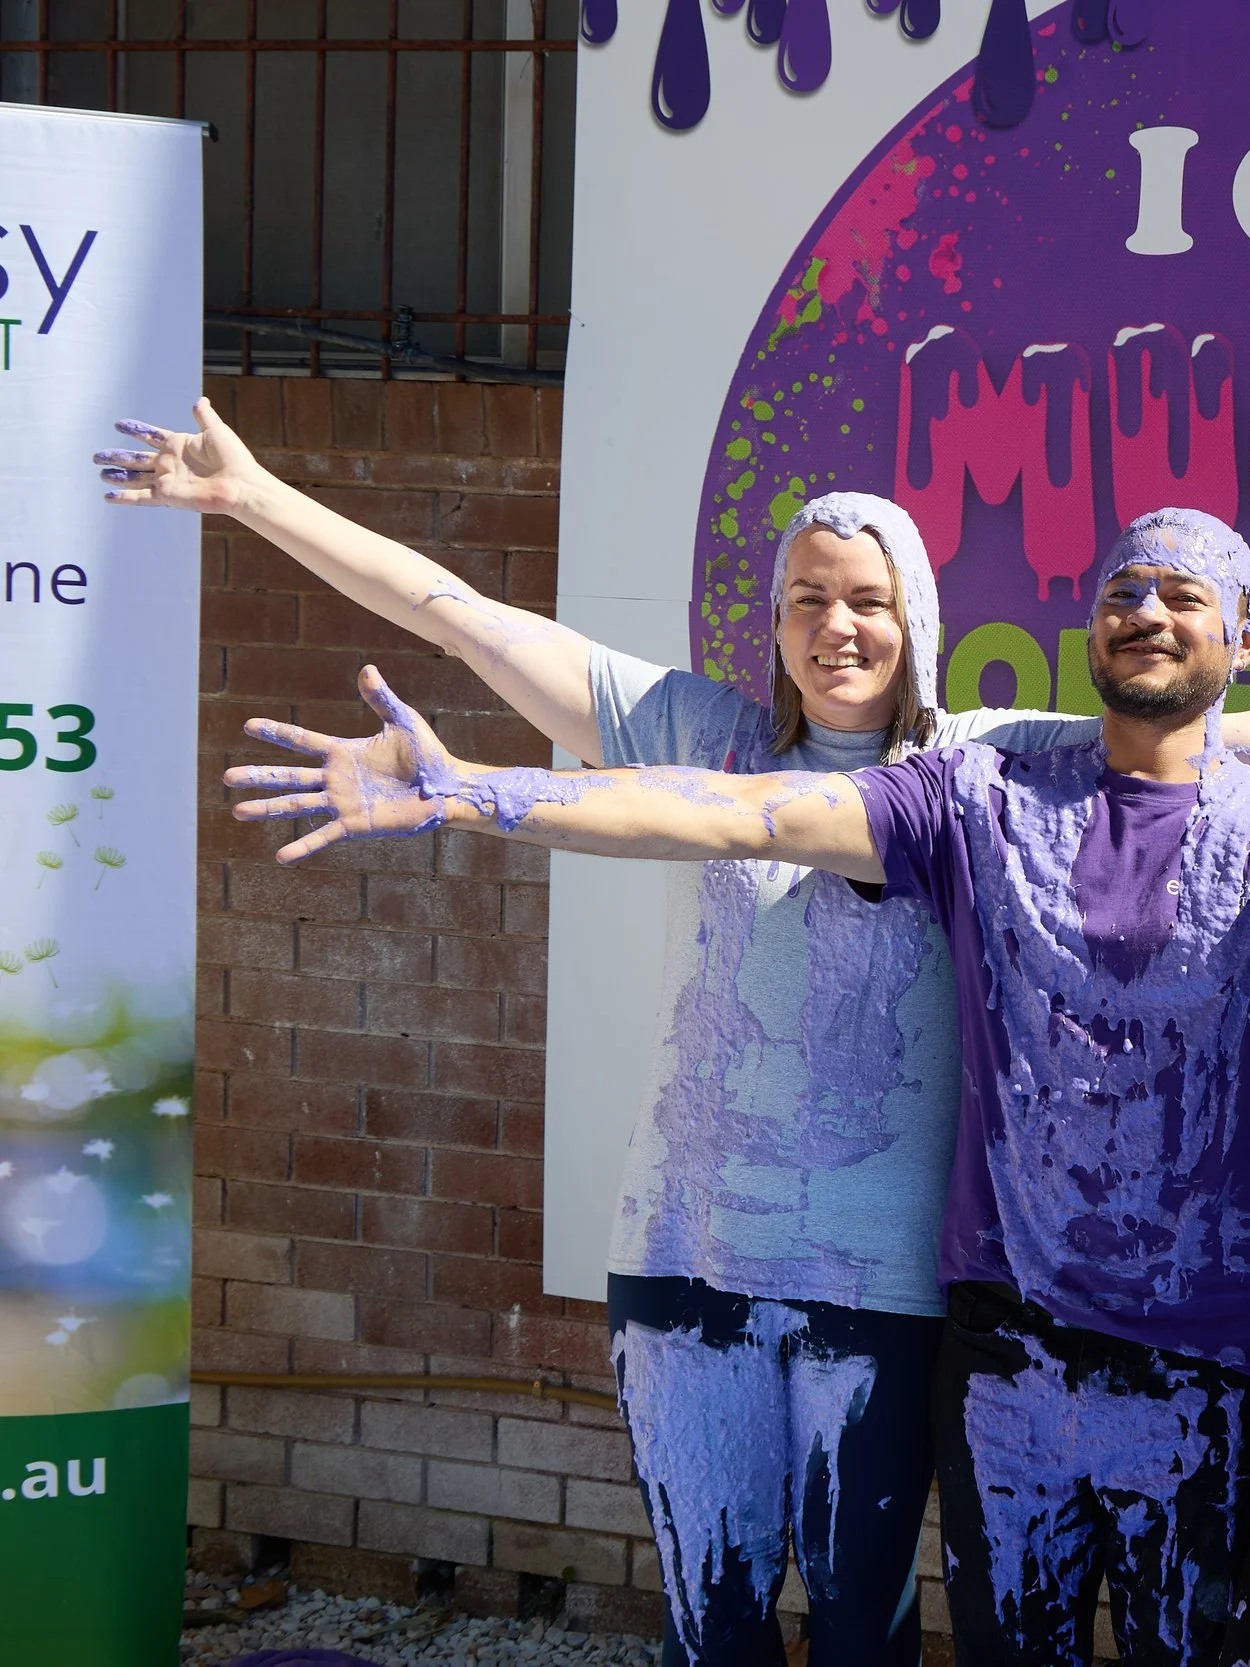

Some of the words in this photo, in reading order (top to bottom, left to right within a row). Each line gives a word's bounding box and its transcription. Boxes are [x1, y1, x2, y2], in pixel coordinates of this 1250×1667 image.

[1125, 126, 1199, 255] I
[5, 561, 88, 606] ne
[0, 702, 97, 773] 53
[1, 1456, 107, 1501] .au
